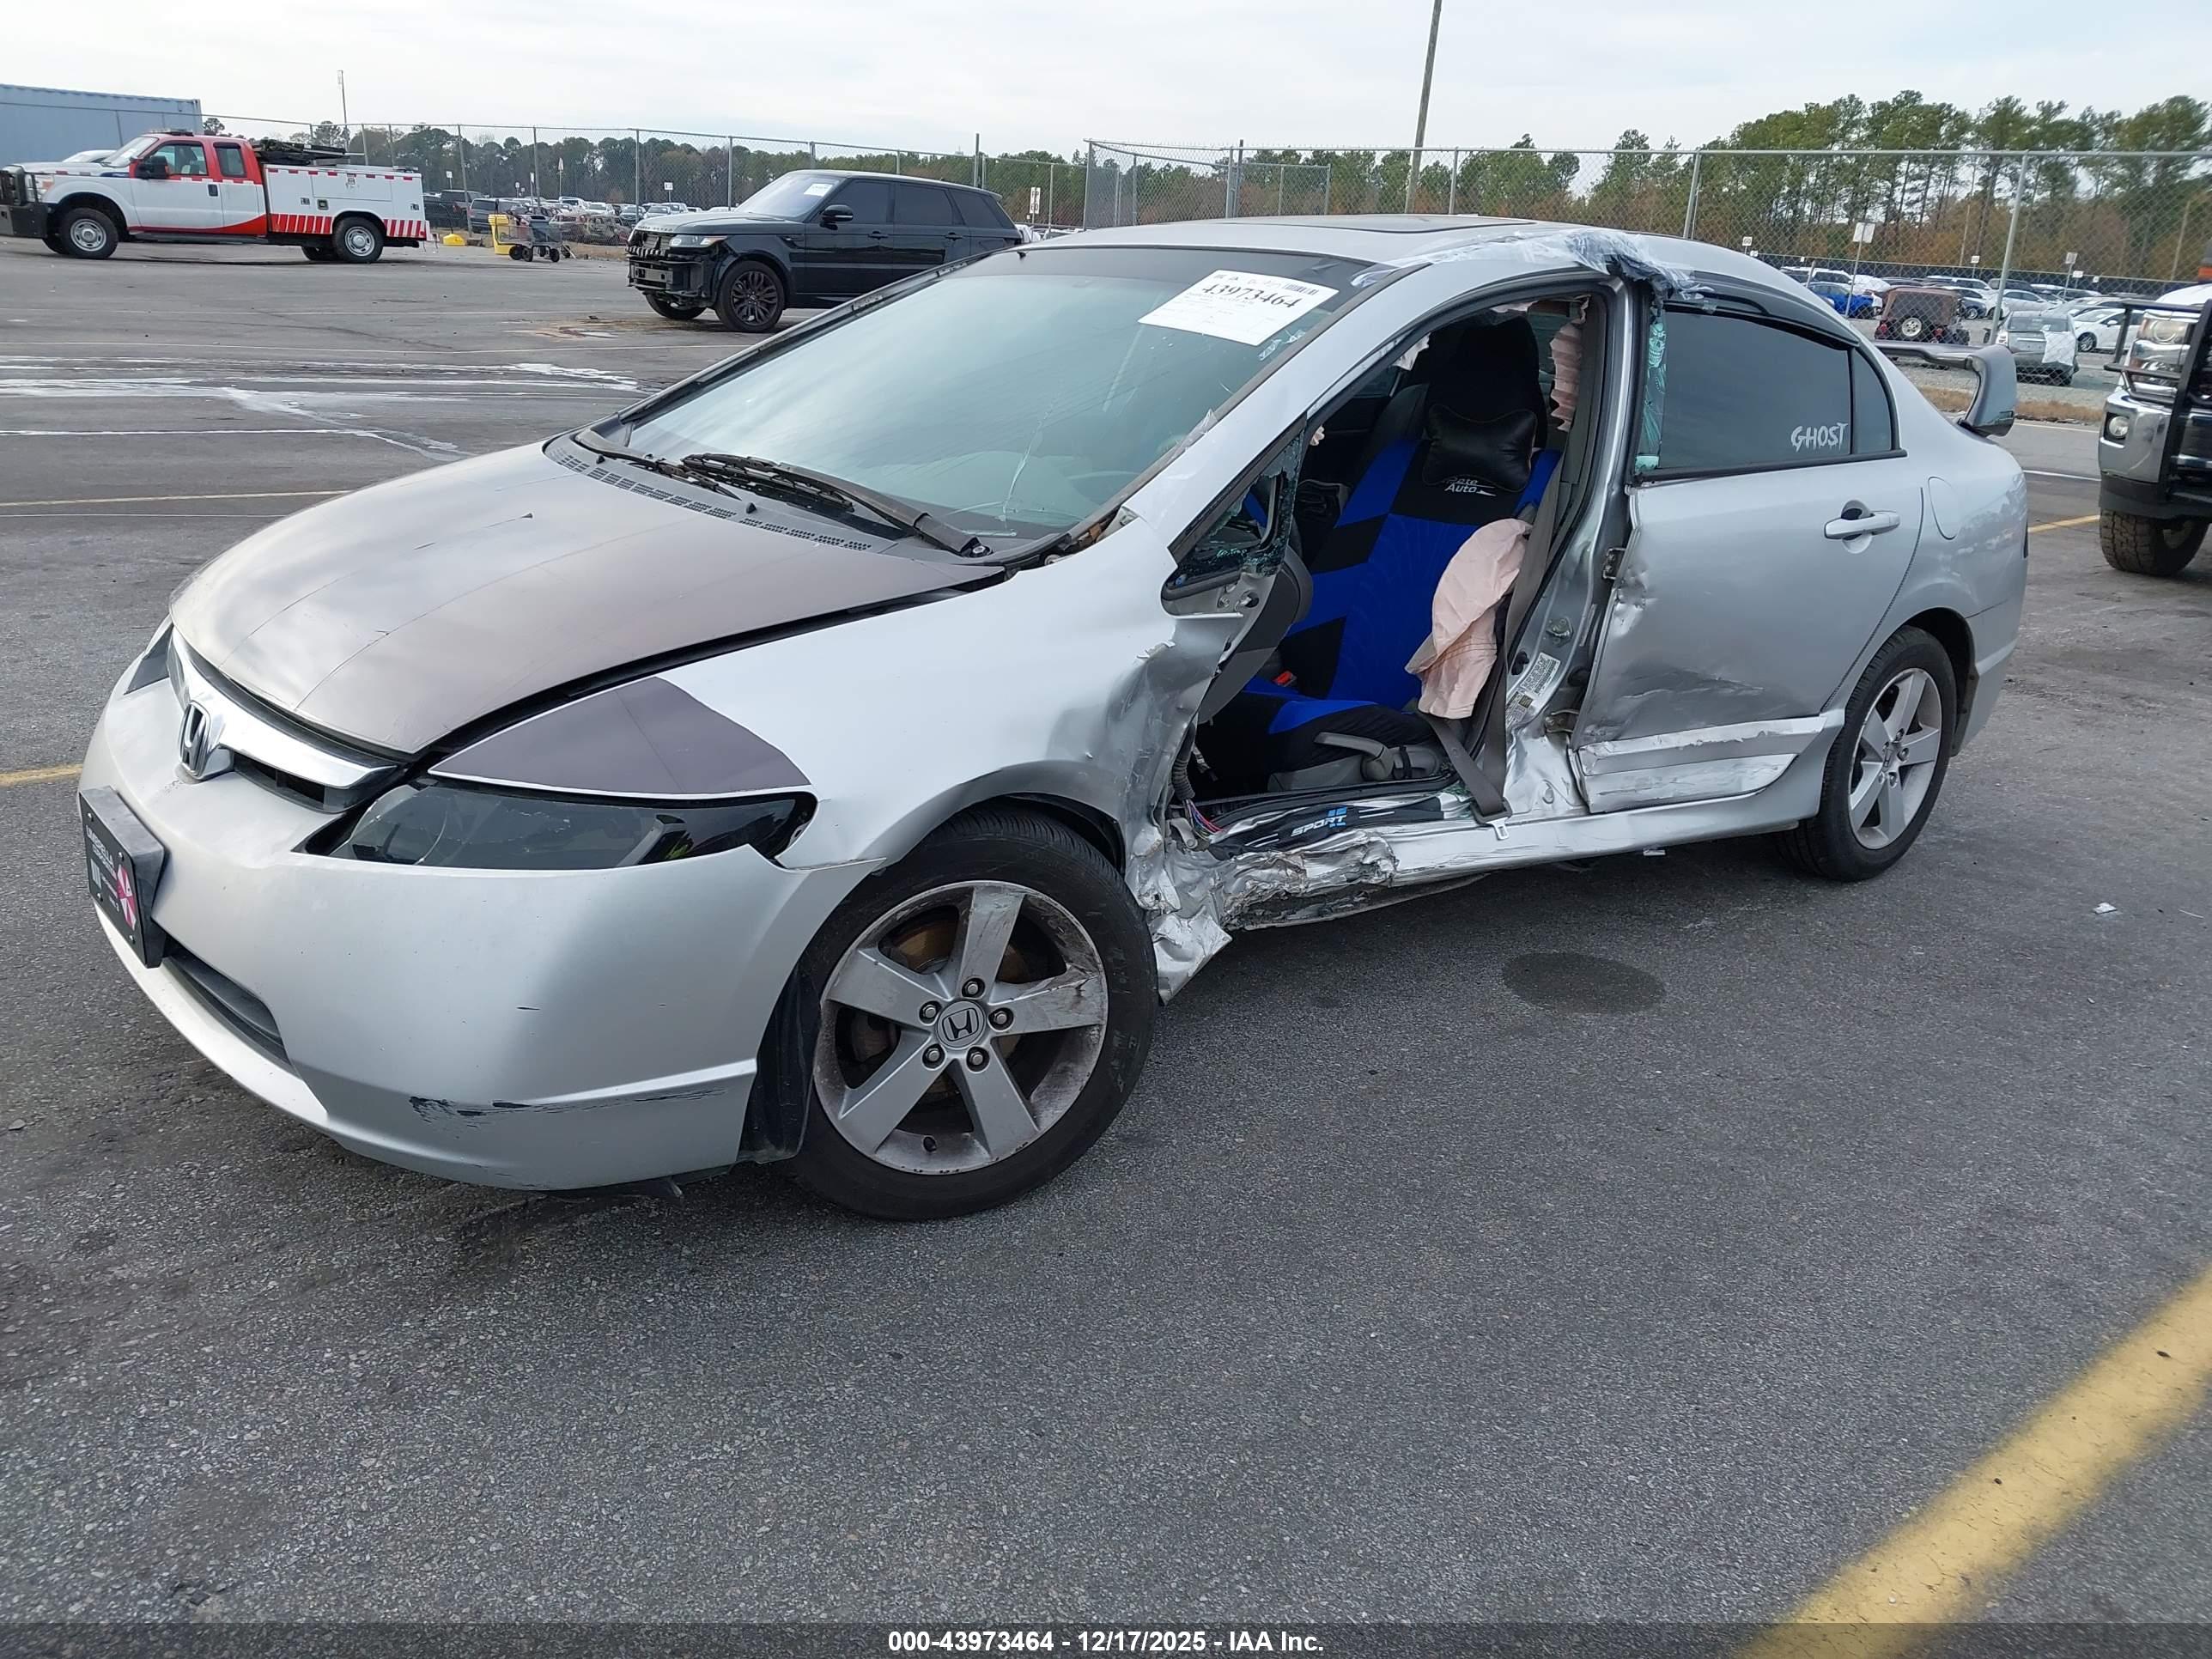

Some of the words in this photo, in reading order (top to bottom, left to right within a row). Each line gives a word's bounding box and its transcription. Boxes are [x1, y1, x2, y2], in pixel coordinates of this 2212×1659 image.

[1202, 283, 1302, 308] 43973464
[1790, 422, 1849, 453] GHOST
[1443, 483, 1478, 493] Auto
[1291, 814, 1347, 837] SPORT
